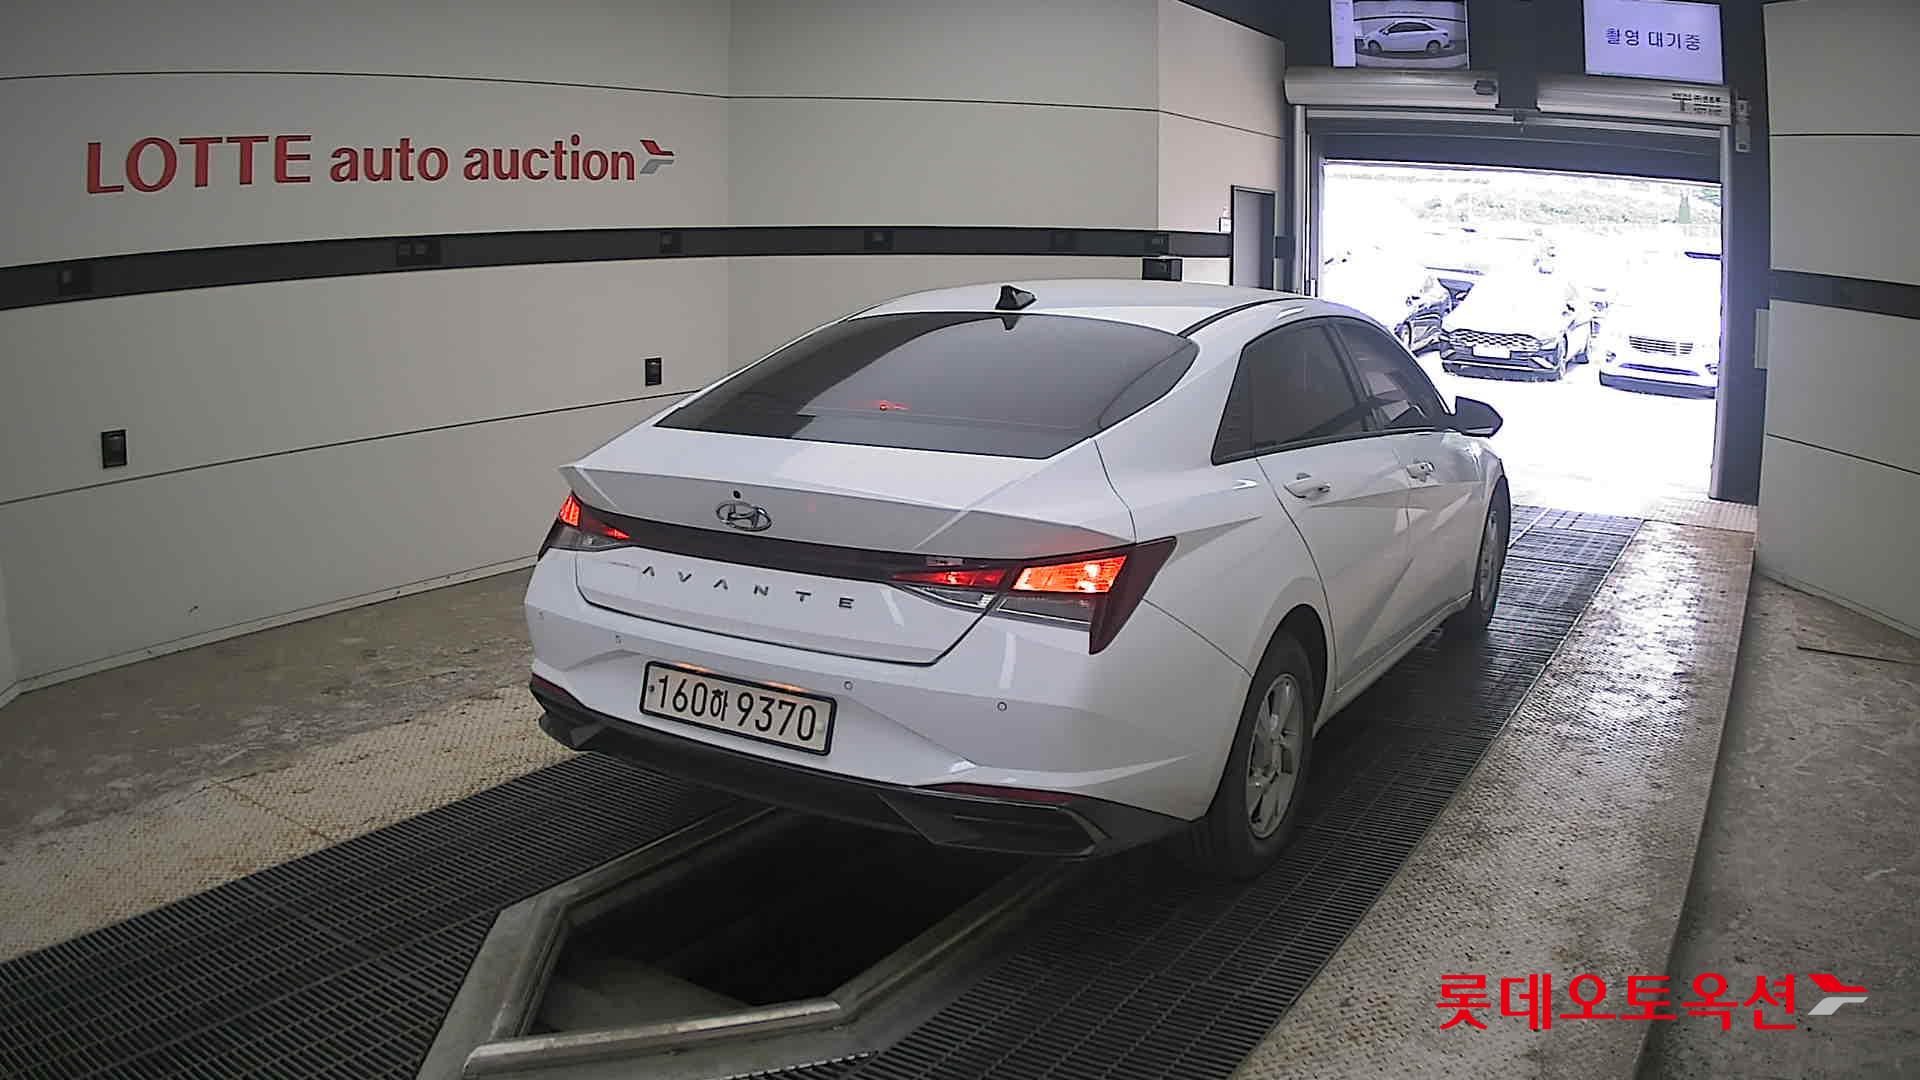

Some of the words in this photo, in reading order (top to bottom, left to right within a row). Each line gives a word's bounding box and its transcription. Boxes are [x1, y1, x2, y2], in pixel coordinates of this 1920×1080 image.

[1648, 31, 1701, 51] 대기중
[87, 134, 312, 194] LOTTE
[329, 137, 449, 182] auto
[463, 133, 635, 181] auction
[641, 565, 855, 609] AVANTE
[658, 675, 729, 722] 160하
[736, 691, 817, 741] 9370
